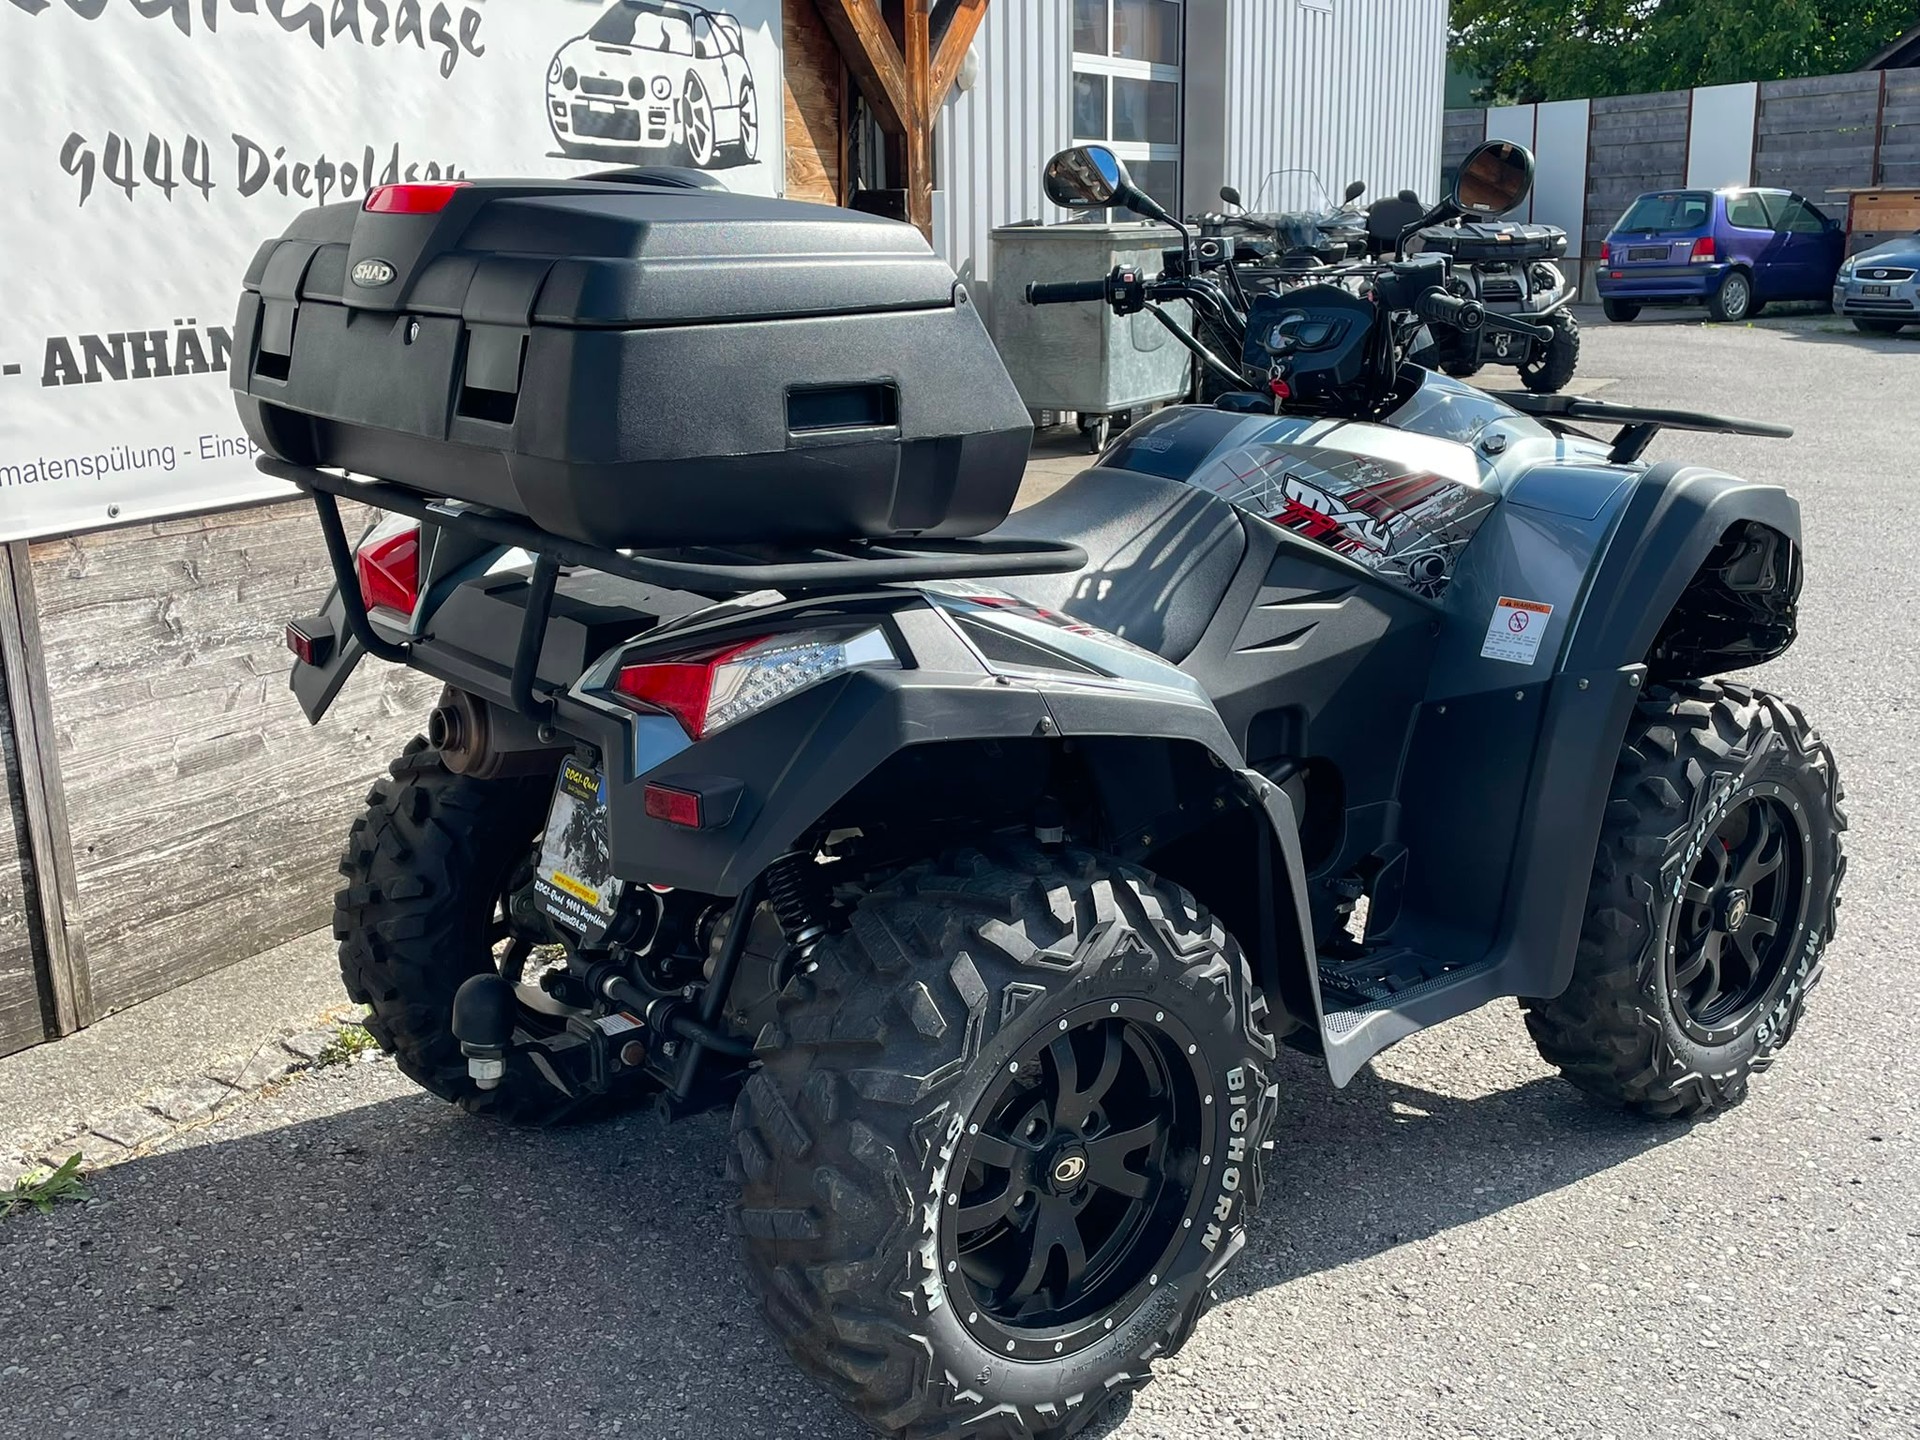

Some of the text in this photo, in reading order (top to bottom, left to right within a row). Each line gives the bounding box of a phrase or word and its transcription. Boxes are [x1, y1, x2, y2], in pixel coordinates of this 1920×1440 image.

[7, 0, 486, 79] -Garage
[60, 132, 216, 207] 9444
[354, 264, 391, 281] SHAD
[1756, 929, 1820, 1044] MAXXIS
[1201, 1066, 1247, 1253] BIGHORN
[919, 1111, 965, 1312] MAXXIS
